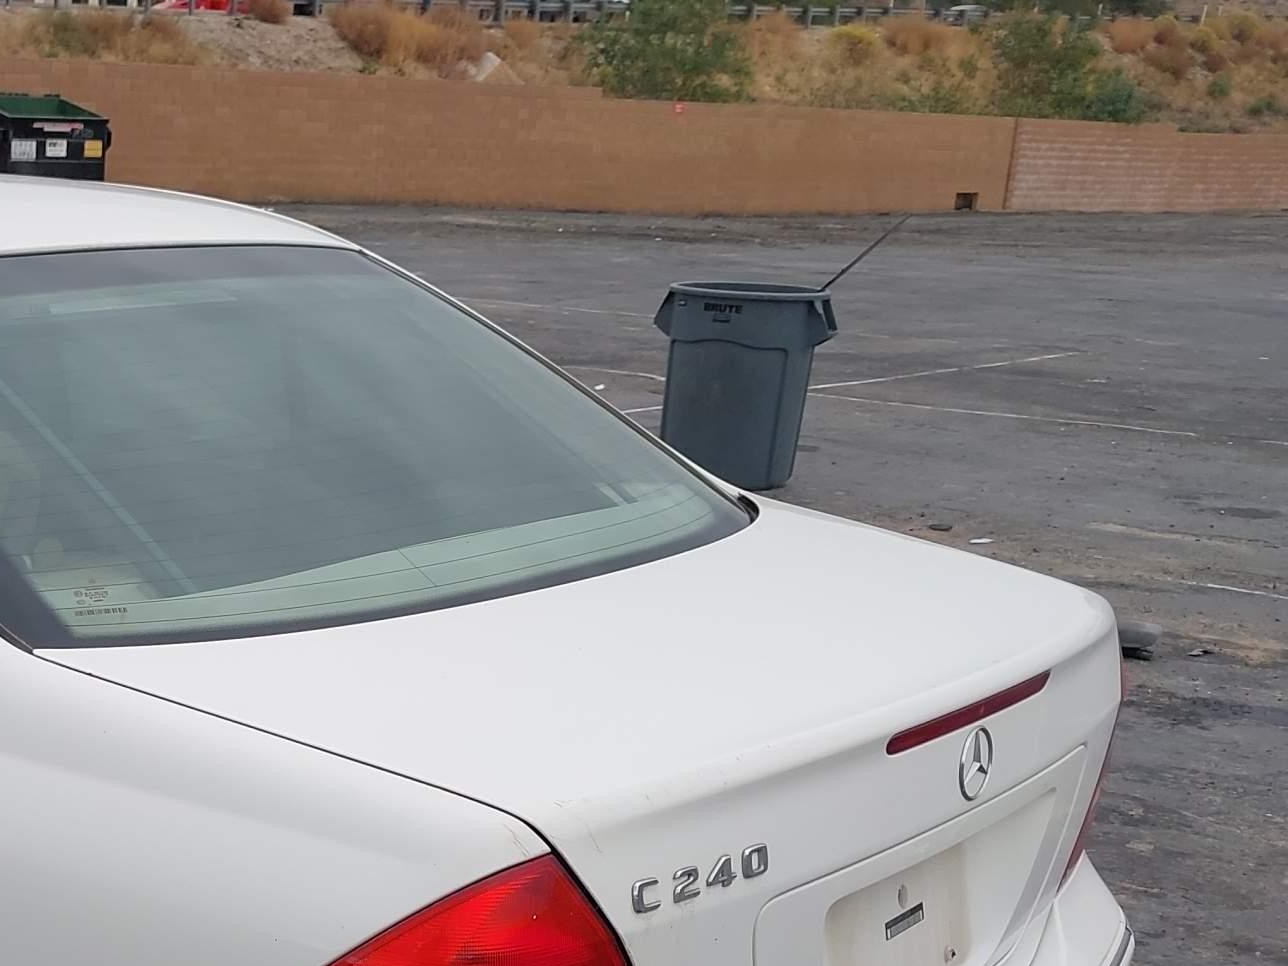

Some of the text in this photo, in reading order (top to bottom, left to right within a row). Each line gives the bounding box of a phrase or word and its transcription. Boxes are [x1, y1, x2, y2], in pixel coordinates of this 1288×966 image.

[703, 302, 743, 314] BRUTE
[631, 843, 769, 914] C 240
